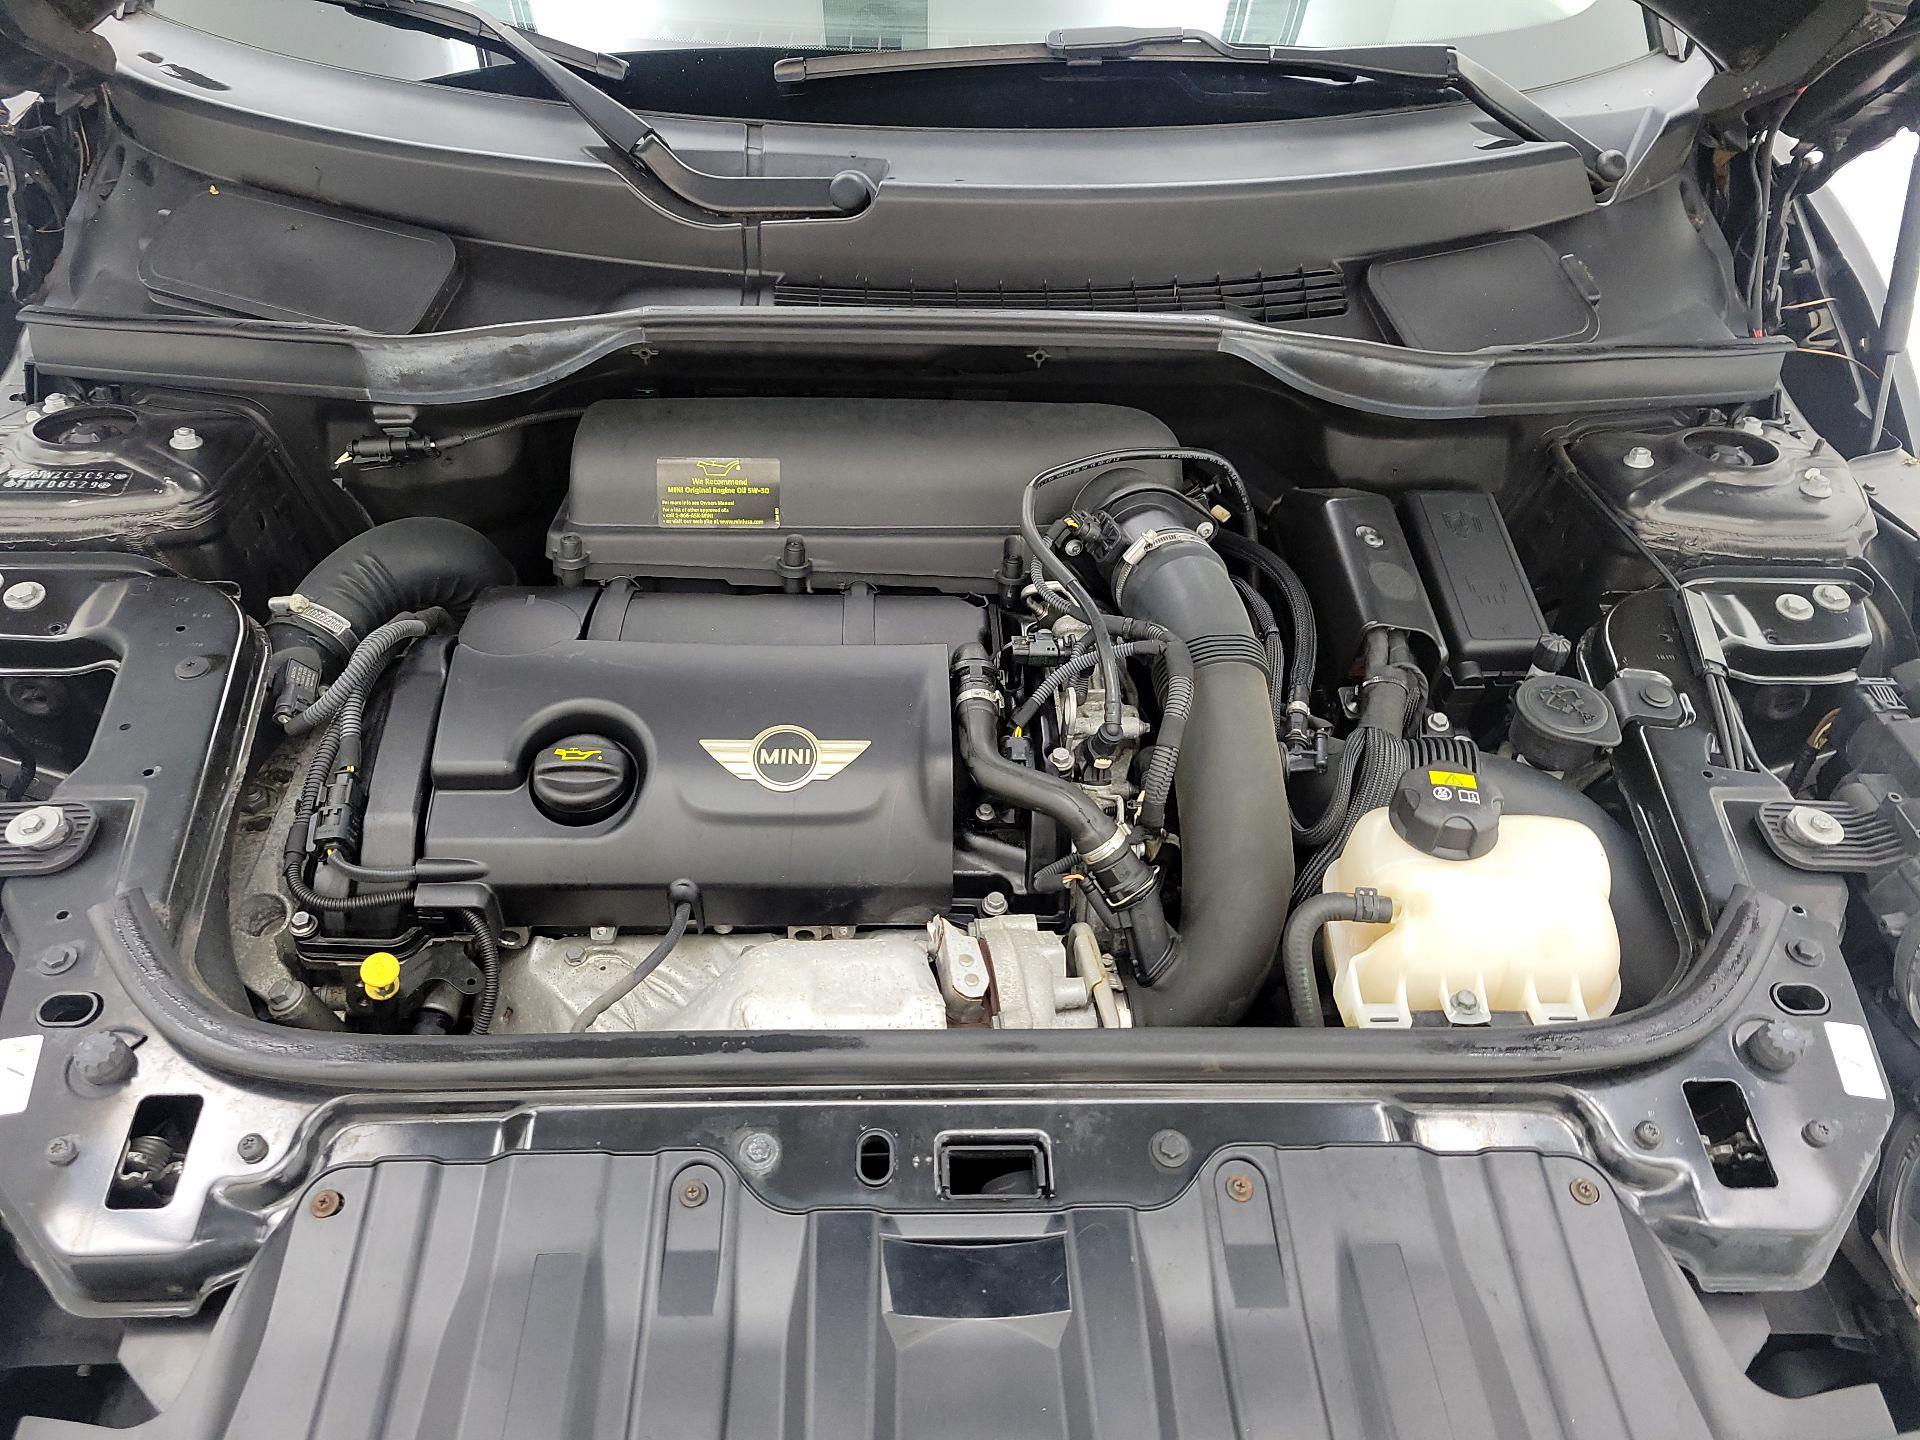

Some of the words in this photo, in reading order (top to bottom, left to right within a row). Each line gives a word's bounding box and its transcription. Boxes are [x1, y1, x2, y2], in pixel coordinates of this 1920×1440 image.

[705, 478, 748, 486] Recommend
[667, 486, 684, 494] MINI
[685, 486, 712, 495] Original
[713, 486, 736, 495] Engine
[736, 486, 747, 494] Oil
[759, 748, 811, 765] MINI
